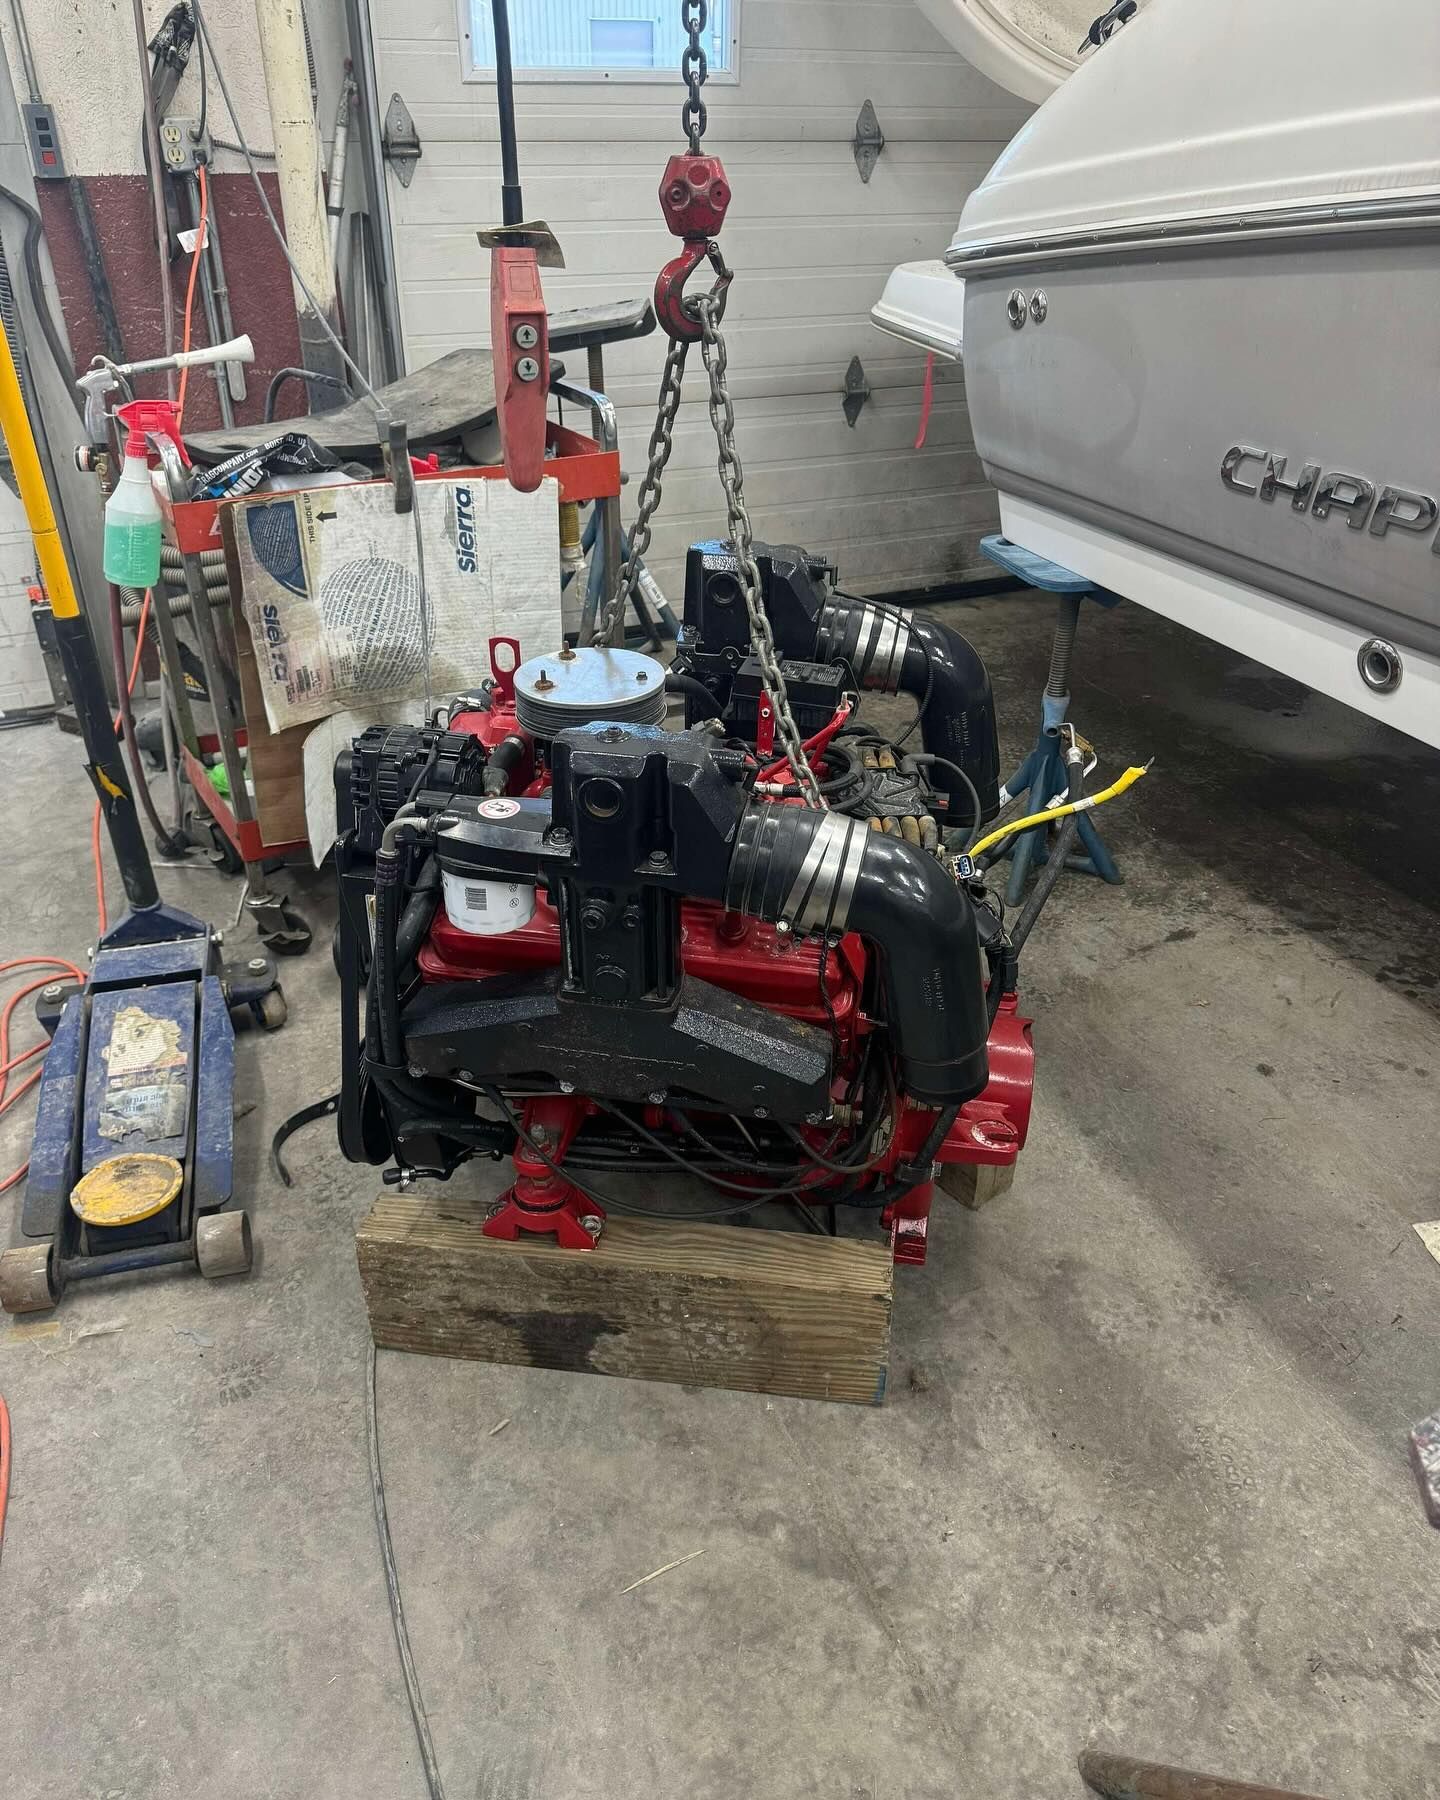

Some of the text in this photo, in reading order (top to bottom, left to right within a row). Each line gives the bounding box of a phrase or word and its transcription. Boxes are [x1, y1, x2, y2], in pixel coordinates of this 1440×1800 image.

[304, 493, 316, 544] THIS SIDE UP
[1221, 445, 1440, 550] CHAP
[371, 597, 385, 625] MARINE
